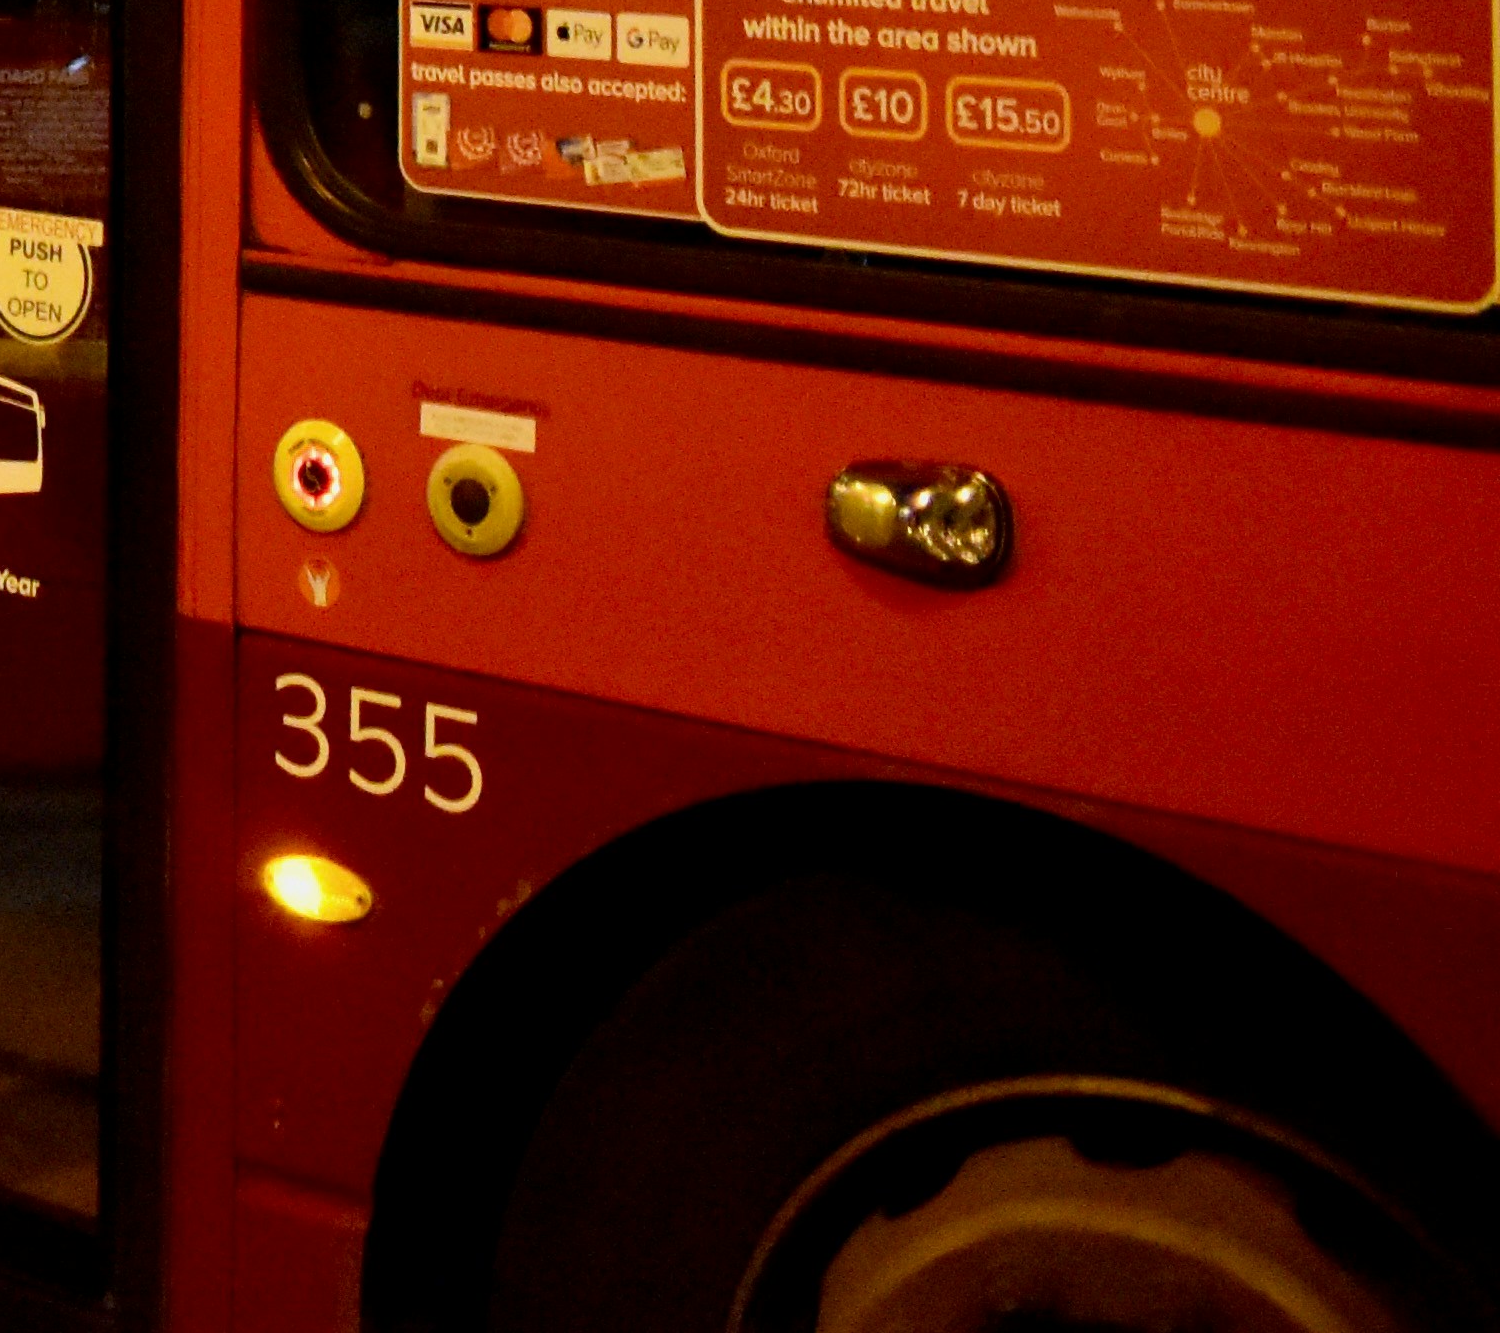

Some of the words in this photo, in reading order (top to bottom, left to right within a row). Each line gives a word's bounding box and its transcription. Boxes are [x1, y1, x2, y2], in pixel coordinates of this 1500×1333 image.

[420, 14, 465, 36] VISA
[573, 23, 603, 46] Pay
[743, 15, 820, 43] within
[828, 19, 870, 46] the
[878, 30, 940, 52] area
[947, 28, 1038, 58] shown
[648, 30, 681, 54] Pay
[410, 61, 465, 84] travel
[469, 68, 536, 90] passes
[541, 73, 583, 94] also
[588, 77, 688, 103] accepted:
[1186, 84, 1250, 104] centre
[730, 77, 812, 117] £4.30
[852, 86, 914, 125] £10
[955, 94, 1061, 136] £15.50
[723, 187, 764, 209] 24hr
[770, 194, 819, 215] ticket
[882, 183, 932, 206] ticket
[957, 189, 967, 208] 7
[972, 191, 1004, 216] day
[1010, 195, 1062, 217] ticket
[10, 237, 63, 262] PUSH
[23, 269, 49, 291] TO
[7, 298, 62, 323] OPEN
[274, 672, 483, 814] 355
